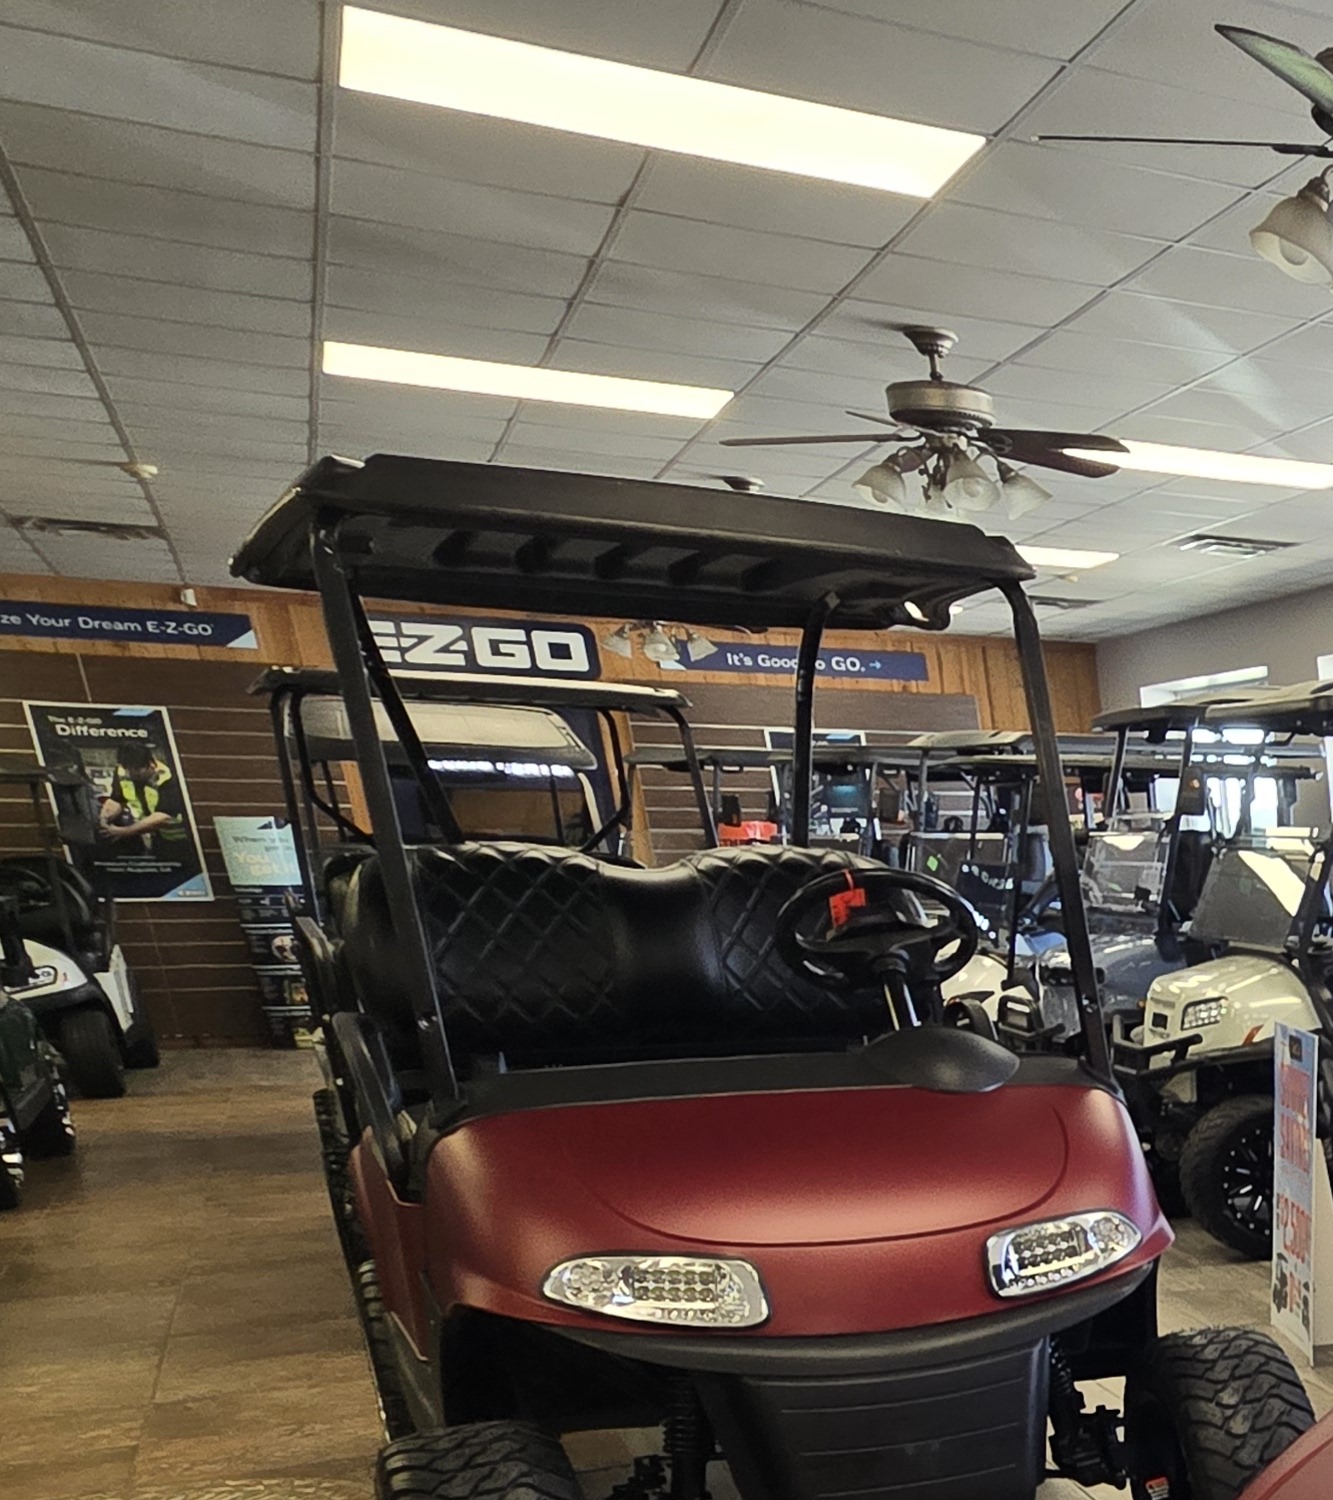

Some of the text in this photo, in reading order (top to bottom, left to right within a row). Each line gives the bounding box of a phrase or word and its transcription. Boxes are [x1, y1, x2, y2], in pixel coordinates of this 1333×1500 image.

[25, 612, 71, 628] Your
[77, 616, 142, 632] Dream
[146, 620, 213, 636] E-Z-GO
[726, 652, 753, 667] It's
[54, 723, 149, 738] Difference
